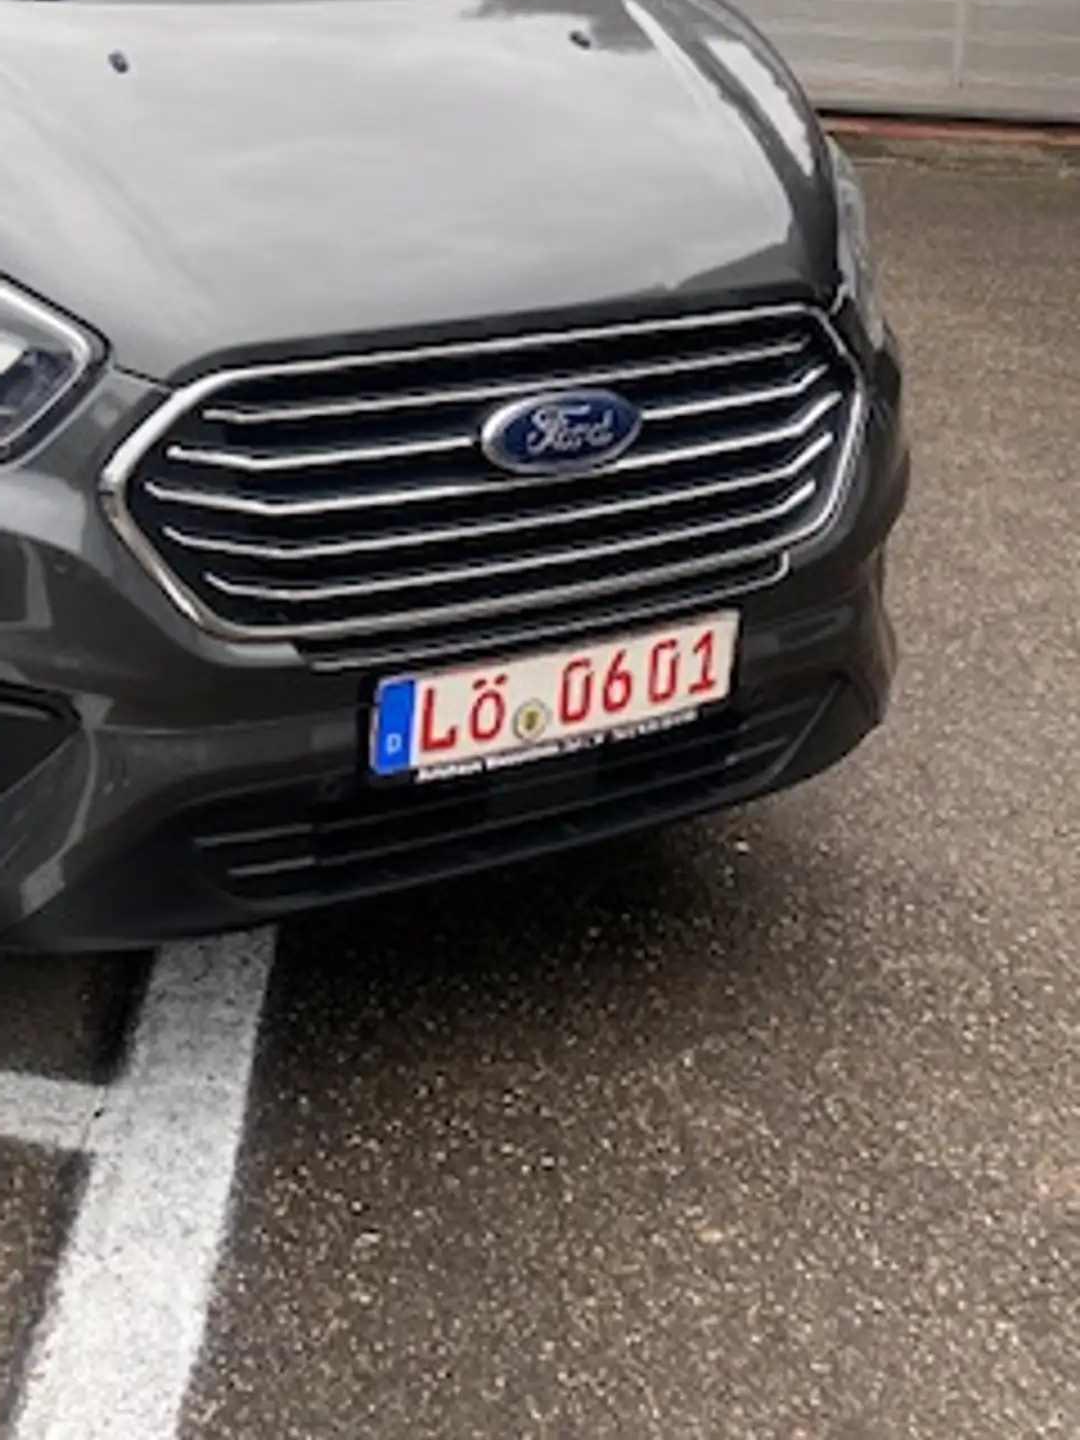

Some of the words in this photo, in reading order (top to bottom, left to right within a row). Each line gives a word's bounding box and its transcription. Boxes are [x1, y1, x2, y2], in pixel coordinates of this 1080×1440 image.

[525, 403, 614, 455] Ford
[422, 674, 507, 751] LÖ
[559, 631, 716, 723] 0601
[386, 732, 402, 756] D
